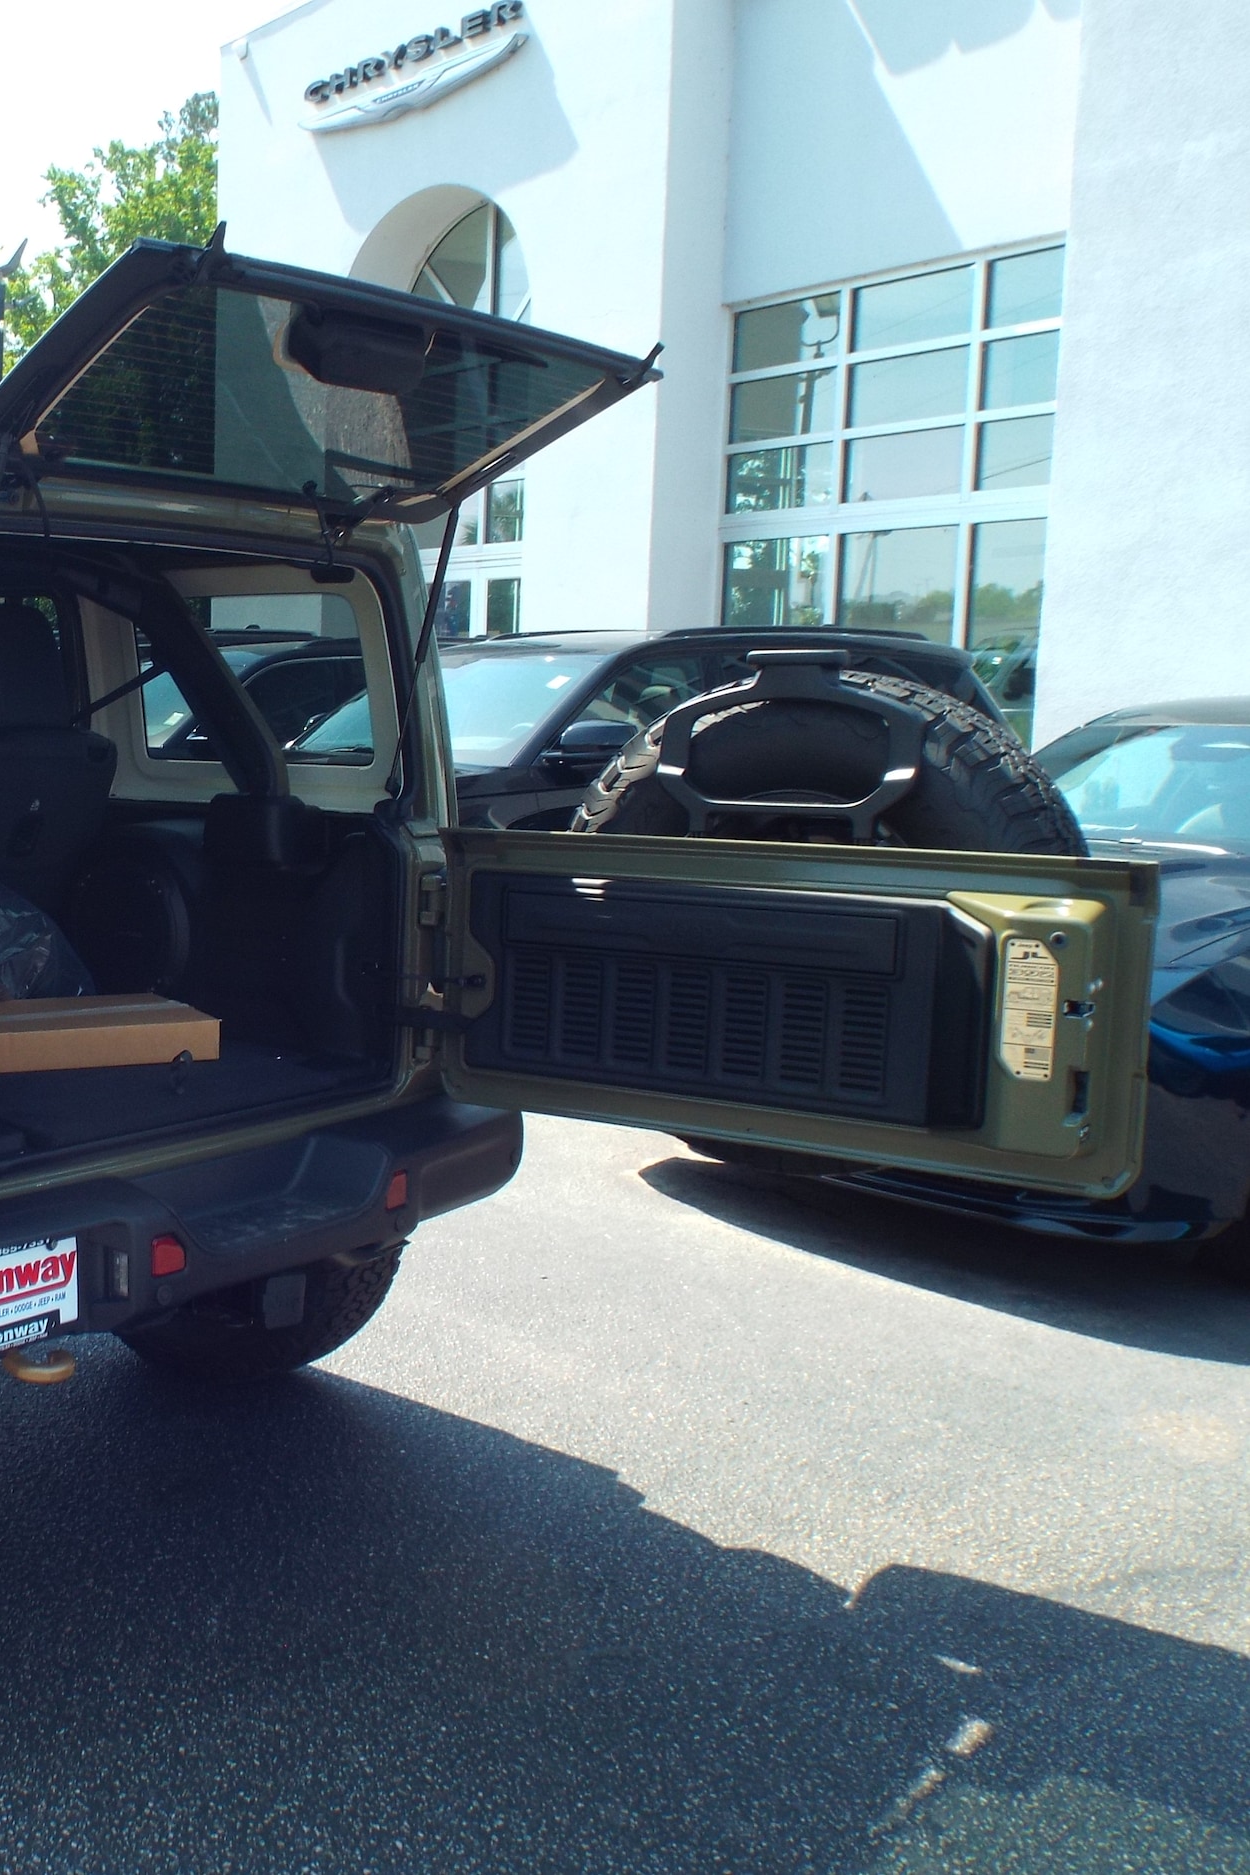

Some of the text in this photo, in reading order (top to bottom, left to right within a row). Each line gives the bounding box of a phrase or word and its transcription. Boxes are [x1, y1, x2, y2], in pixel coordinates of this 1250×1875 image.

[304, 0, 524, 104] CHRYSLER
[14, 1301, 33, 1314] DODGE
[37, 1296, 50, 1307] JEEP
[54, 1291, 66, 1302] RAM
